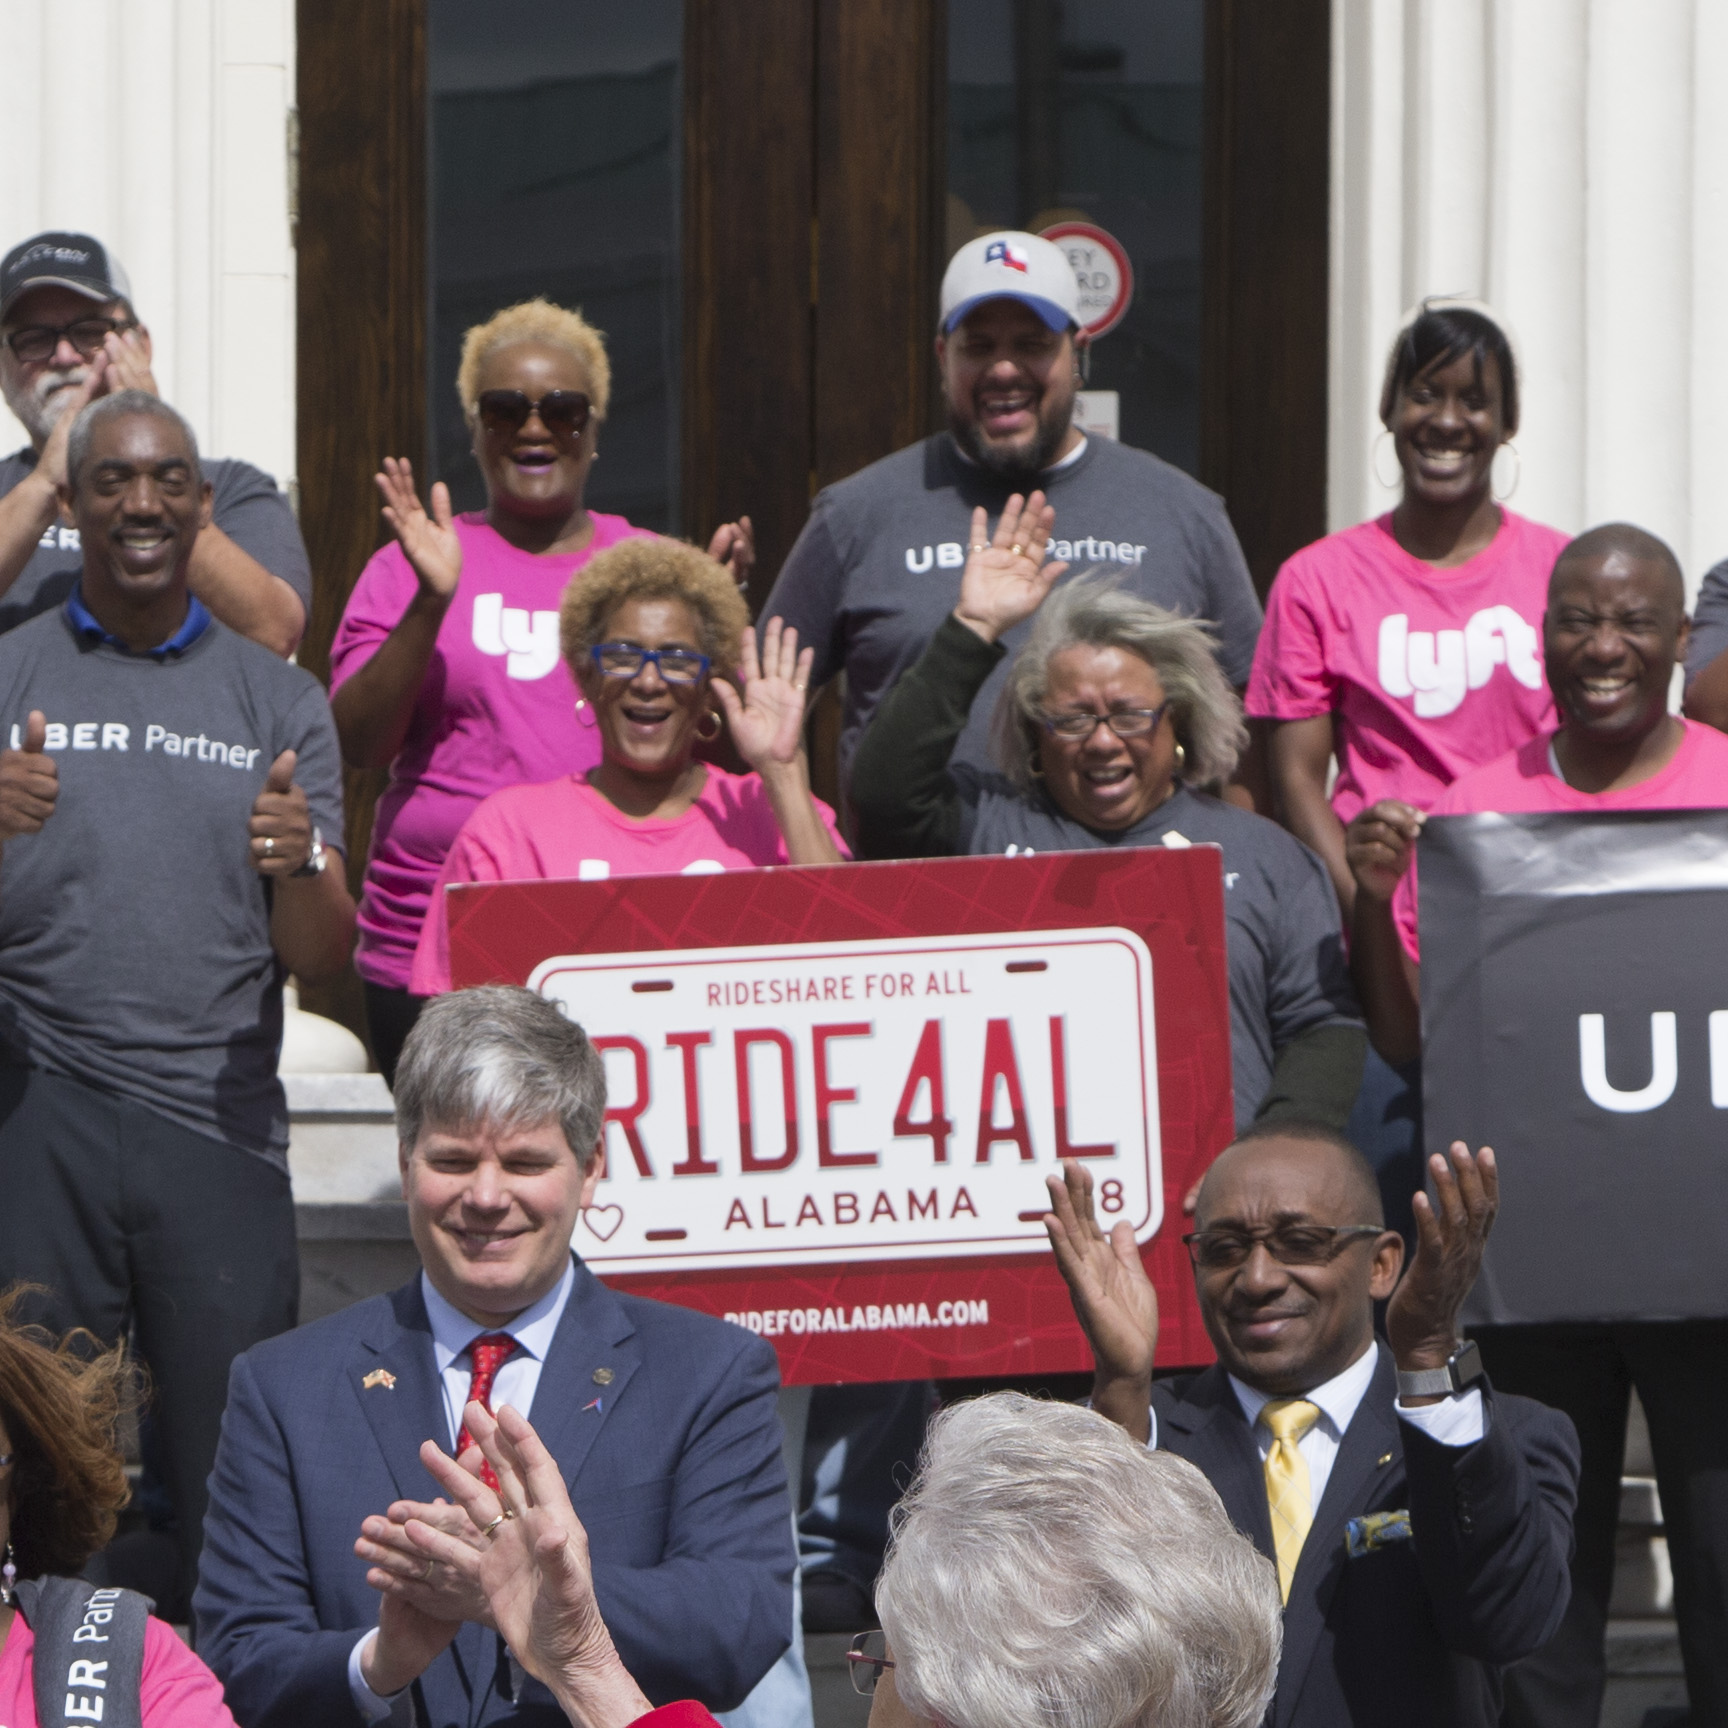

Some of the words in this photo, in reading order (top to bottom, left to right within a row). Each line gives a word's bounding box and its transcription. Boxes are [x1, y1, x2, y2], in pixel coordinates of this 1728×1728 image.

[1068, 248, 1096, 267] EY
[38, 525, 81, 552] ER
[905, 541, 990, 574] UB
[472, 592, 561, 681] ly
[1377, 604, 1543, 719] lyft
[144, 724, 262, 771] Partner
[706, 975, 855, 1008] RIDESHARE
[864, 972, 915, 999] FOR
[925, 969, 973, 996] ALL
[589, 1014, 1117, 1181] RIDE4AL
[723, 1185, 980, 1232] ALABAMA
